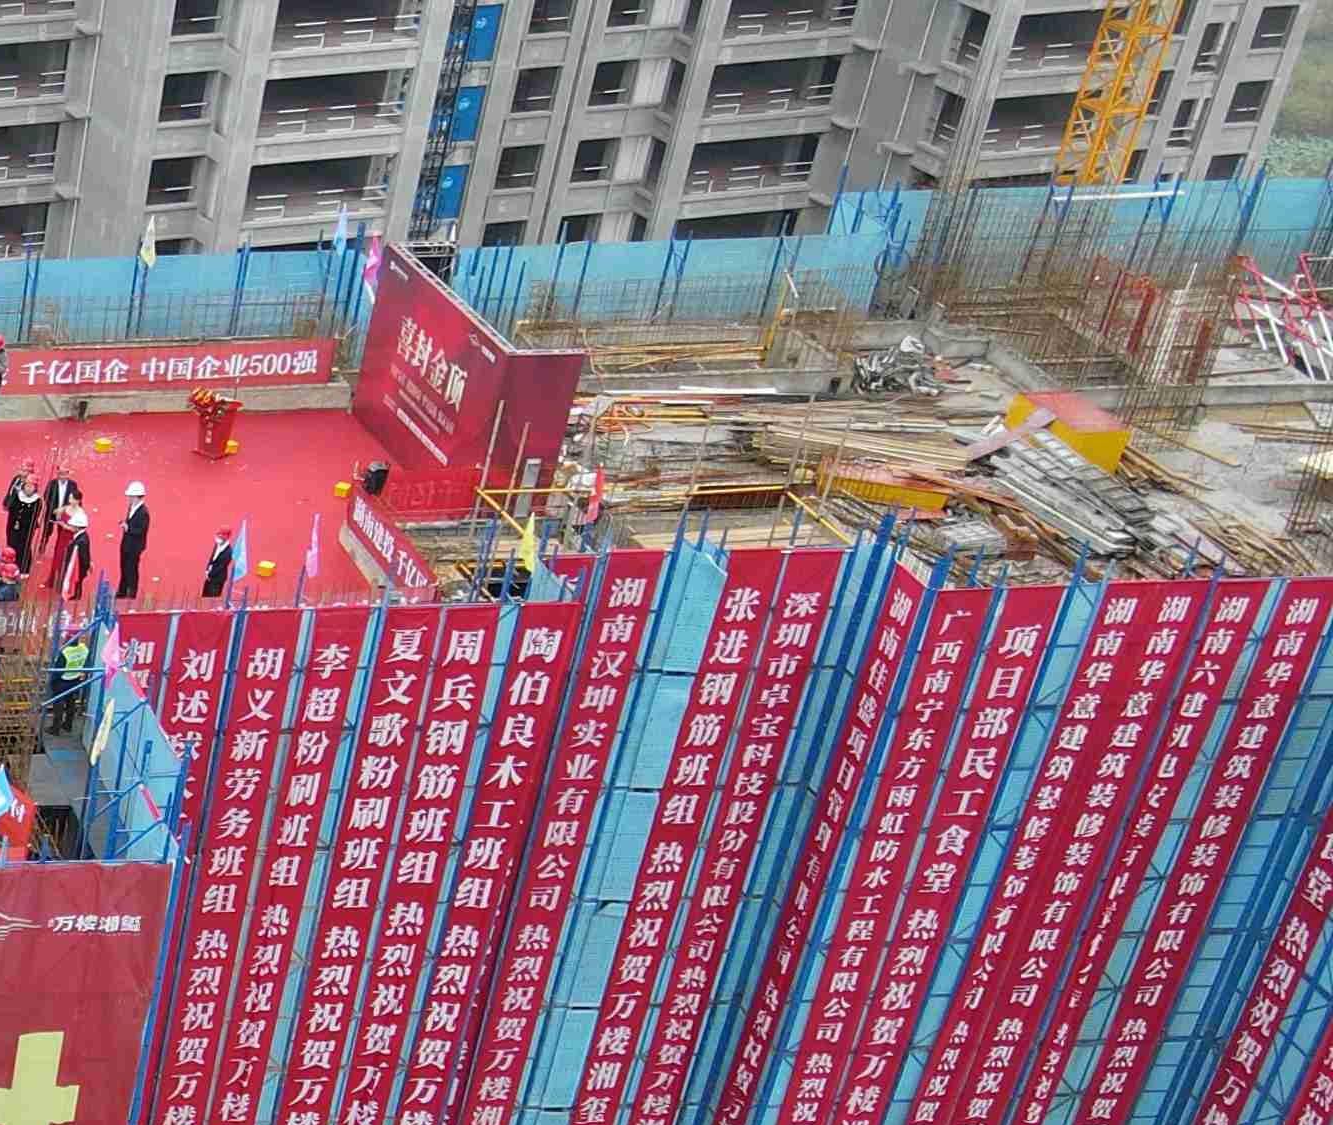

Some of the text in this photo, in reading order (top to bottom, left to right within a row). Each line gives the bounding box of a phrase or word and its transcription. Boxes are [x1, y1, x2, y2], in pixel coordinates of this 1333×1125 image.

[20, 356, 130, 386] 千亿国企
[140, 349, 318, 383] 中国企业500强
[397, 315, 468, 413] 喜封金顶
[201, 647, 285, 913] 胡义新劳务班组
[268, 644, 351, 887] 李超粉刷班组
[333, 627, 428, 909] 夏文歌粉刷班组
[396, 629, 486, 885] 周兵钢筋班组
[454, 627, 564, 909] 陶伯良木工班组
[529, 577, 647, 911] 湖南汉坤实业有限公司
[660, 588, 762, 826] 张进钢筋班组
[816, 608, 973, 1043] 广西南宁东方雨虹防水工程有限公司
[917, 623, 1043, 896] 项目部民工食堂
[1010, 595, 1192, 1007] 湖南华意建筑装修装饰有限公司
[1134, 597, 1318, 1008] 湖南华意建筑装修装饰有限公司
